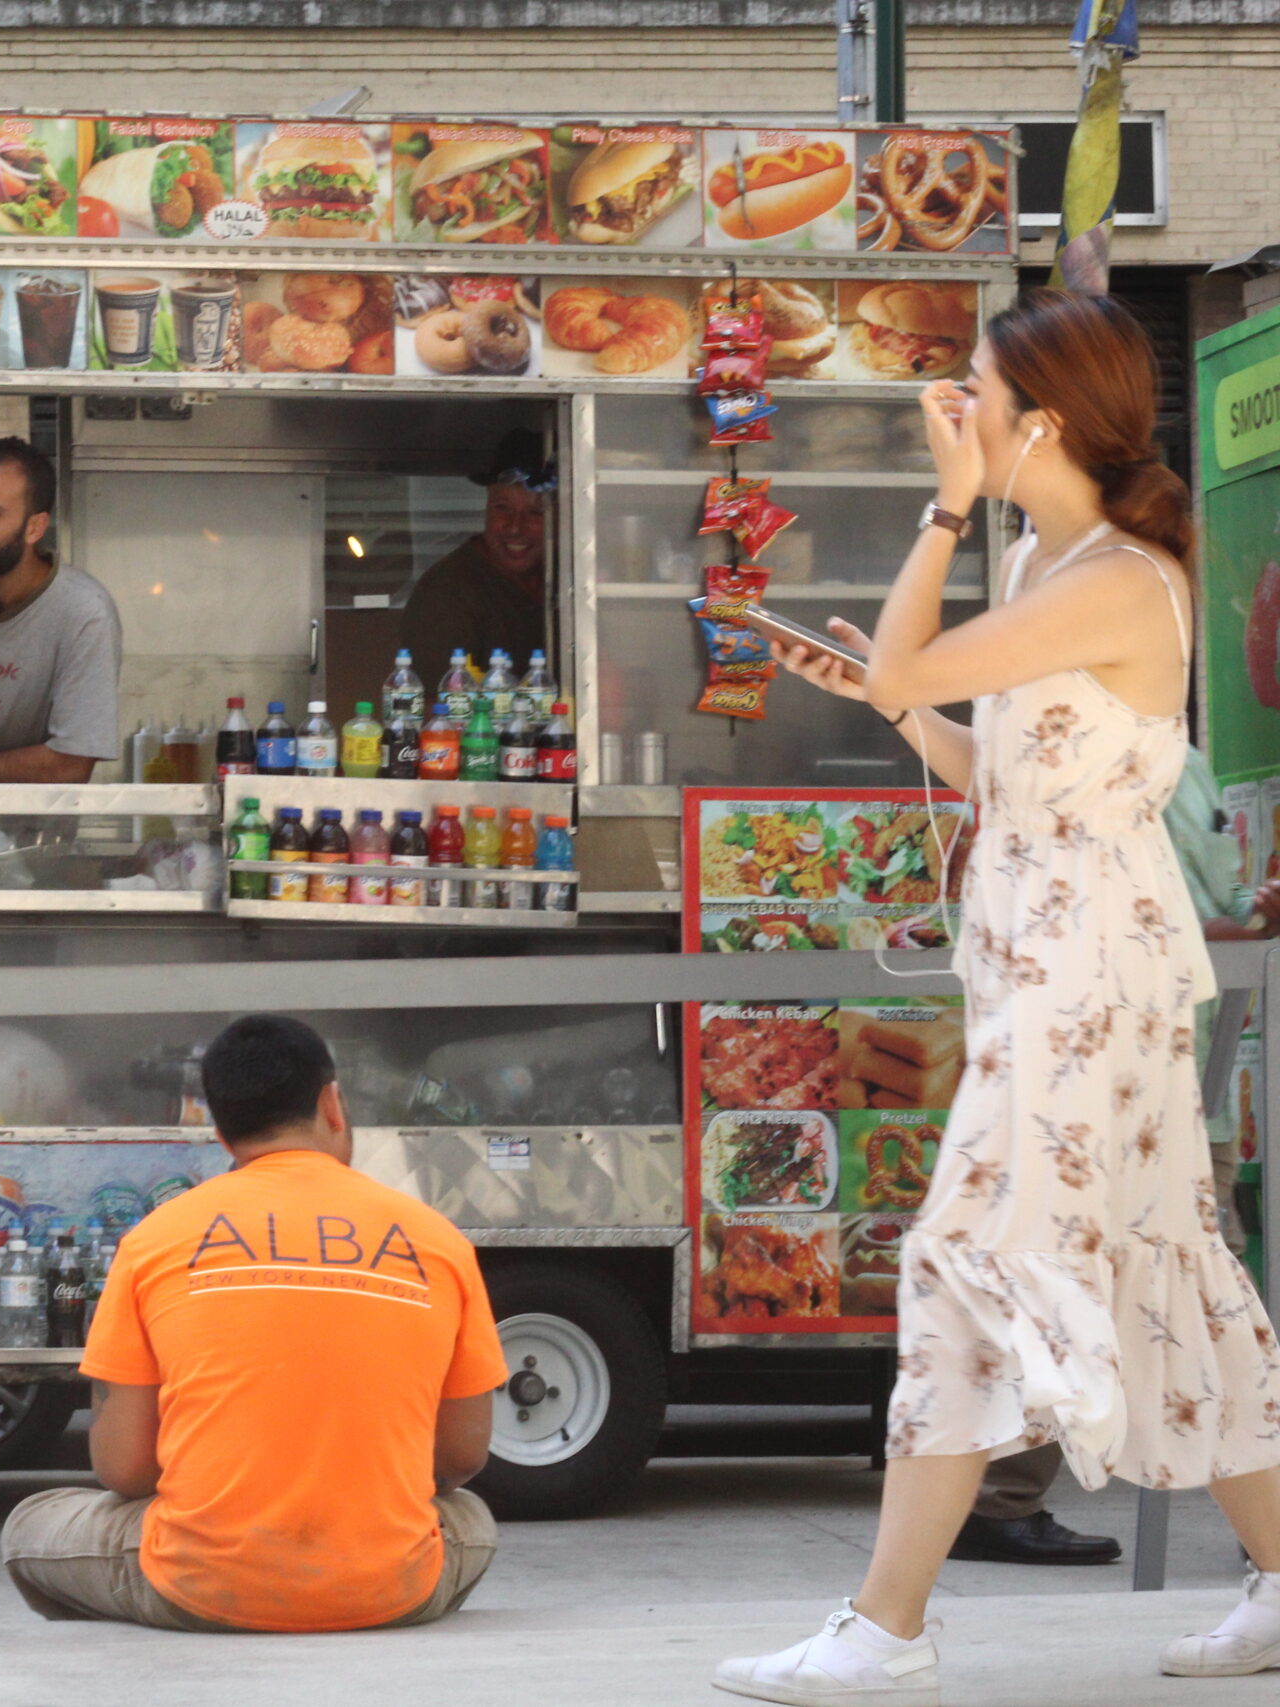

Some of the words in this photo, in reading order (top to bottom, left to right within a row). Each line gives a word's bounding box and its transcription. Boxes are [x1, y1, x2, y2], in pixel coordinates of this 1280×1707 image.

[110, 122, 152, 136] Falafel
[154, 122, 215, 136] Sandwich
[572, 128, 605, 144] Philly
[214, 210, 263, 222] HALAL
[742, 903, 785, 916] KEBAB
[787, 903, 807, 916] ON
[719, 1007, 773, 1020] Chicken
[775, 1007, 820, 1020] Kebab
[880, 1112, 928, 1124] Pretzel
[722, 1214, 771, 1227] Chicken
[187, 1213, 428, 1283] ALBA
